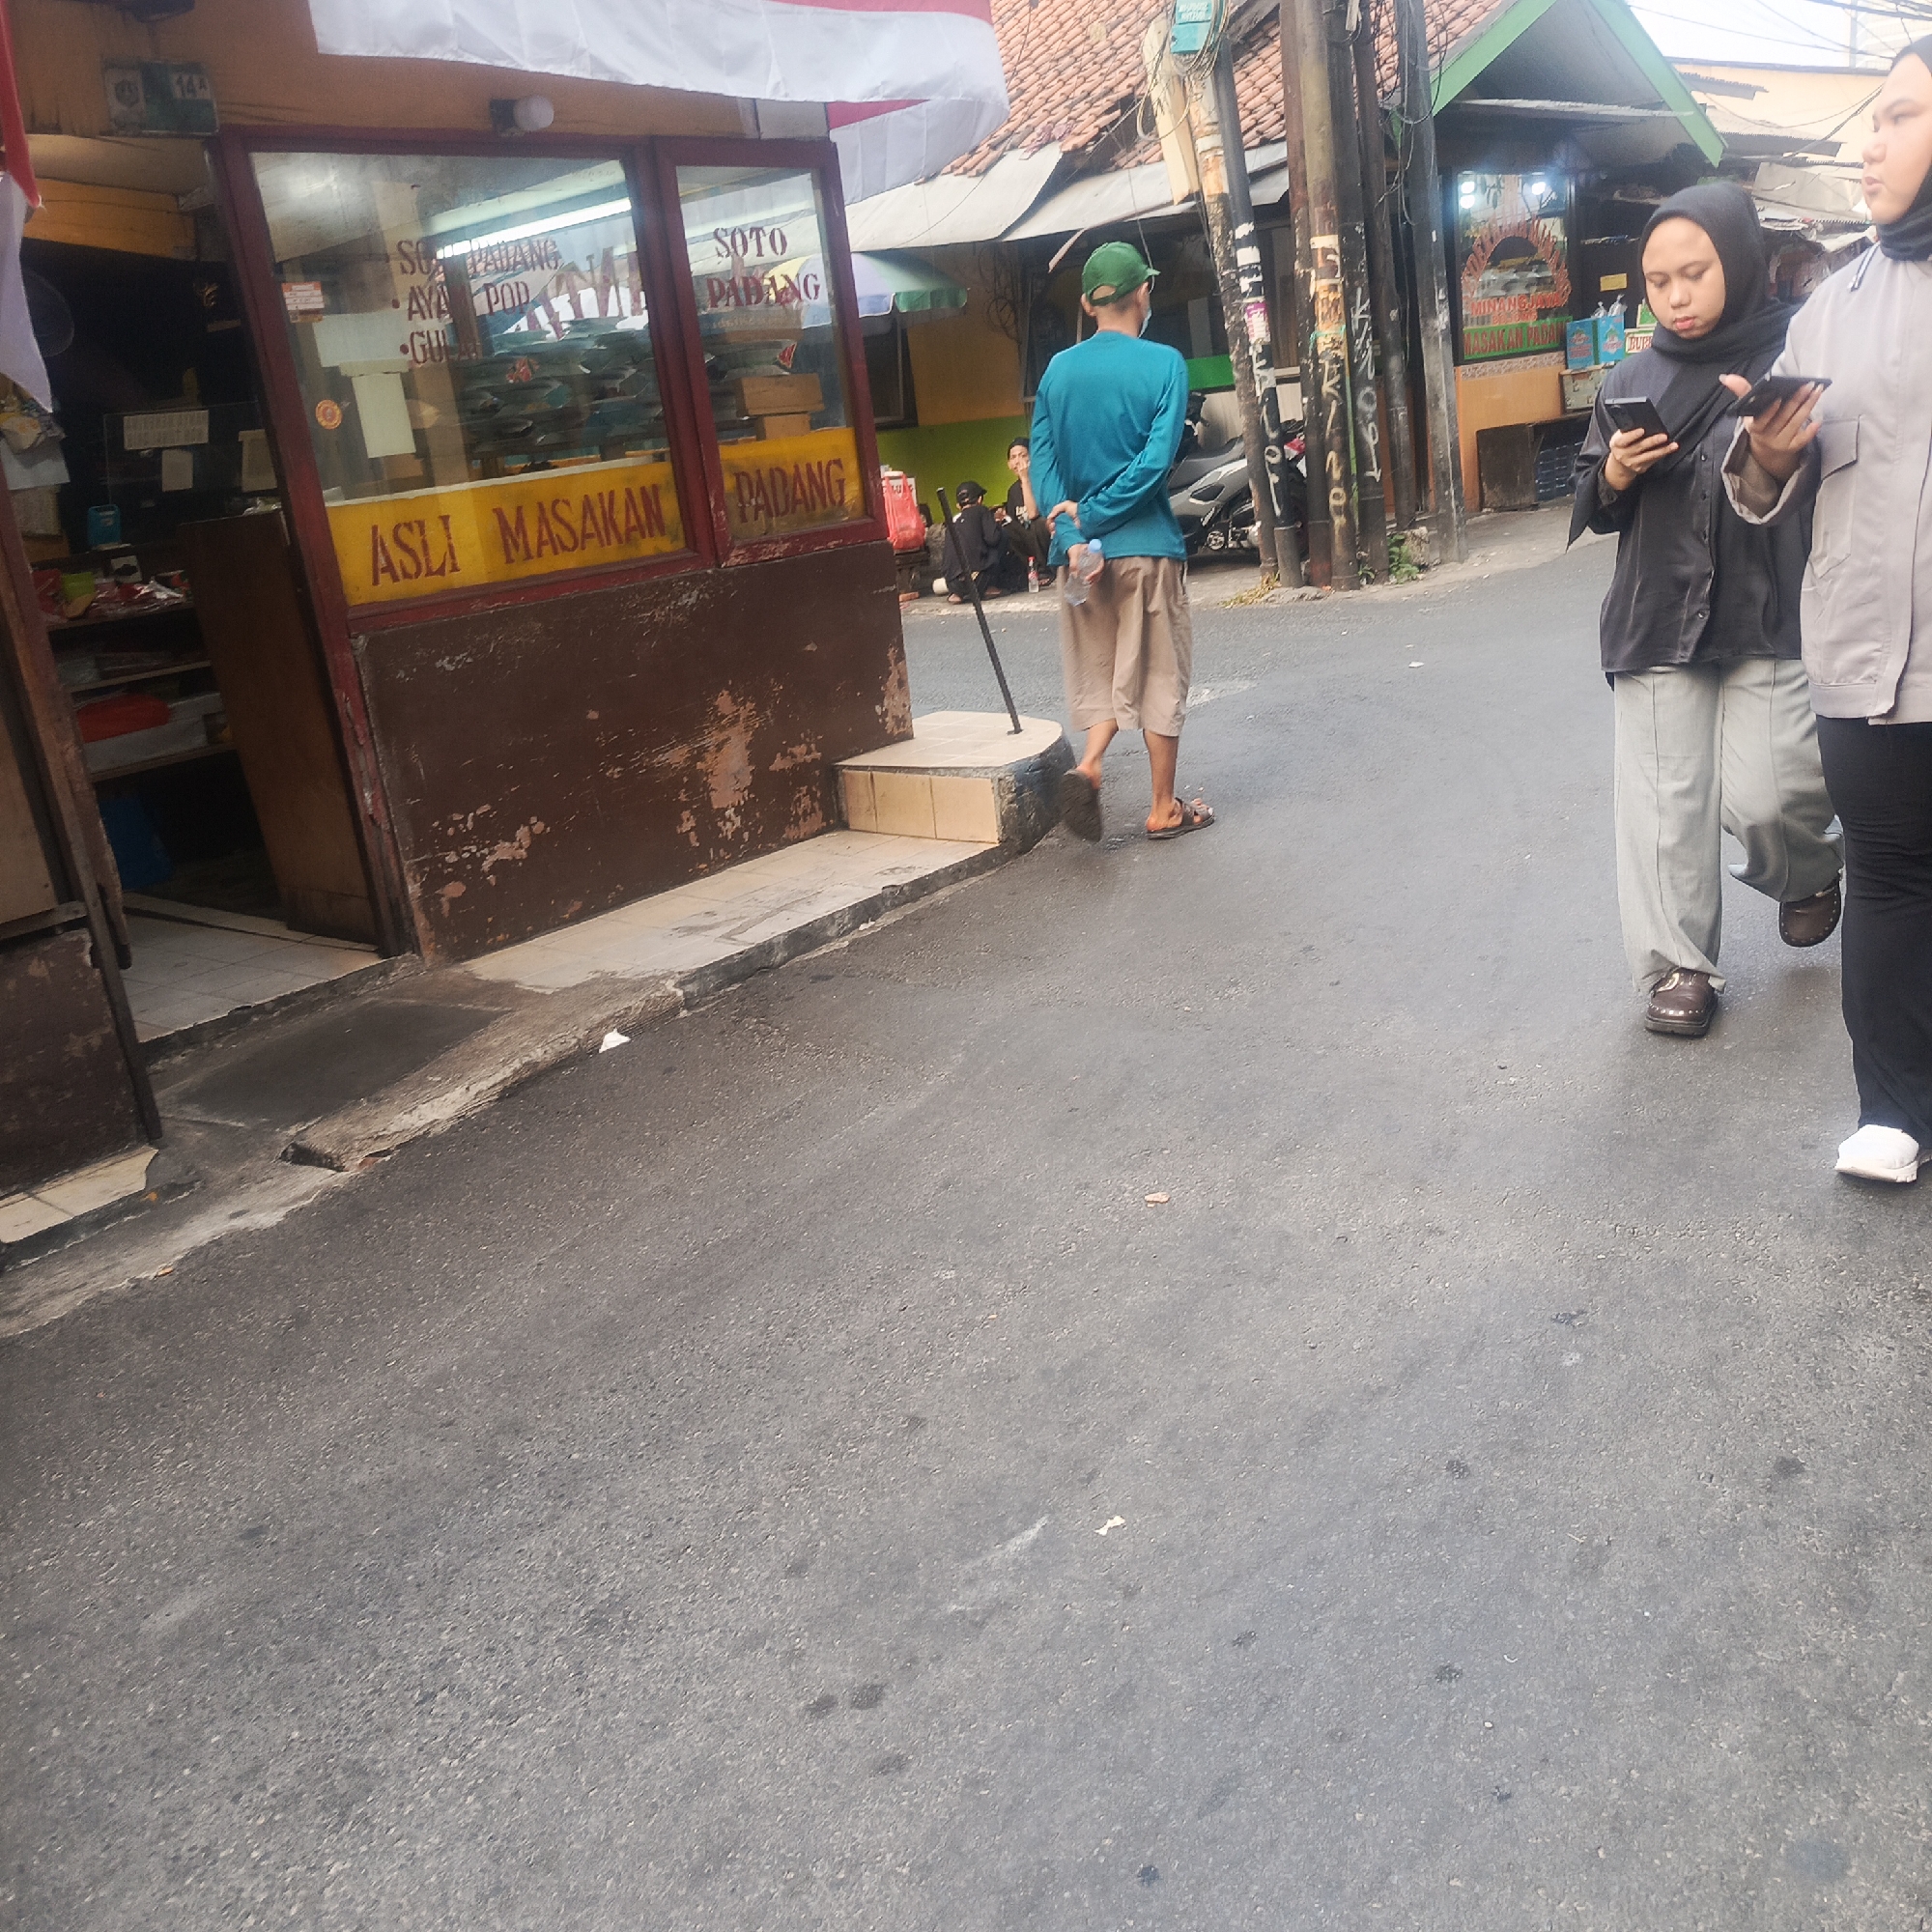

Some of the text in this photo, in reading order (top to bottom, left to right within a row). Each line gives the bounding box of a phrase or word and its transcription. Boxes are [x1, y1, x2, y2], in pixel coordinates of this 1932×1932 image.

[713, 226, 788, 259] SOTO
[483, 279, 531, 317] POP
[705, 272, 821, 309] PADANG
[1463, 327, 1523, 356] MASAKAN
[371, 458, 846, 586] ASLI MASAKAN PADANG
